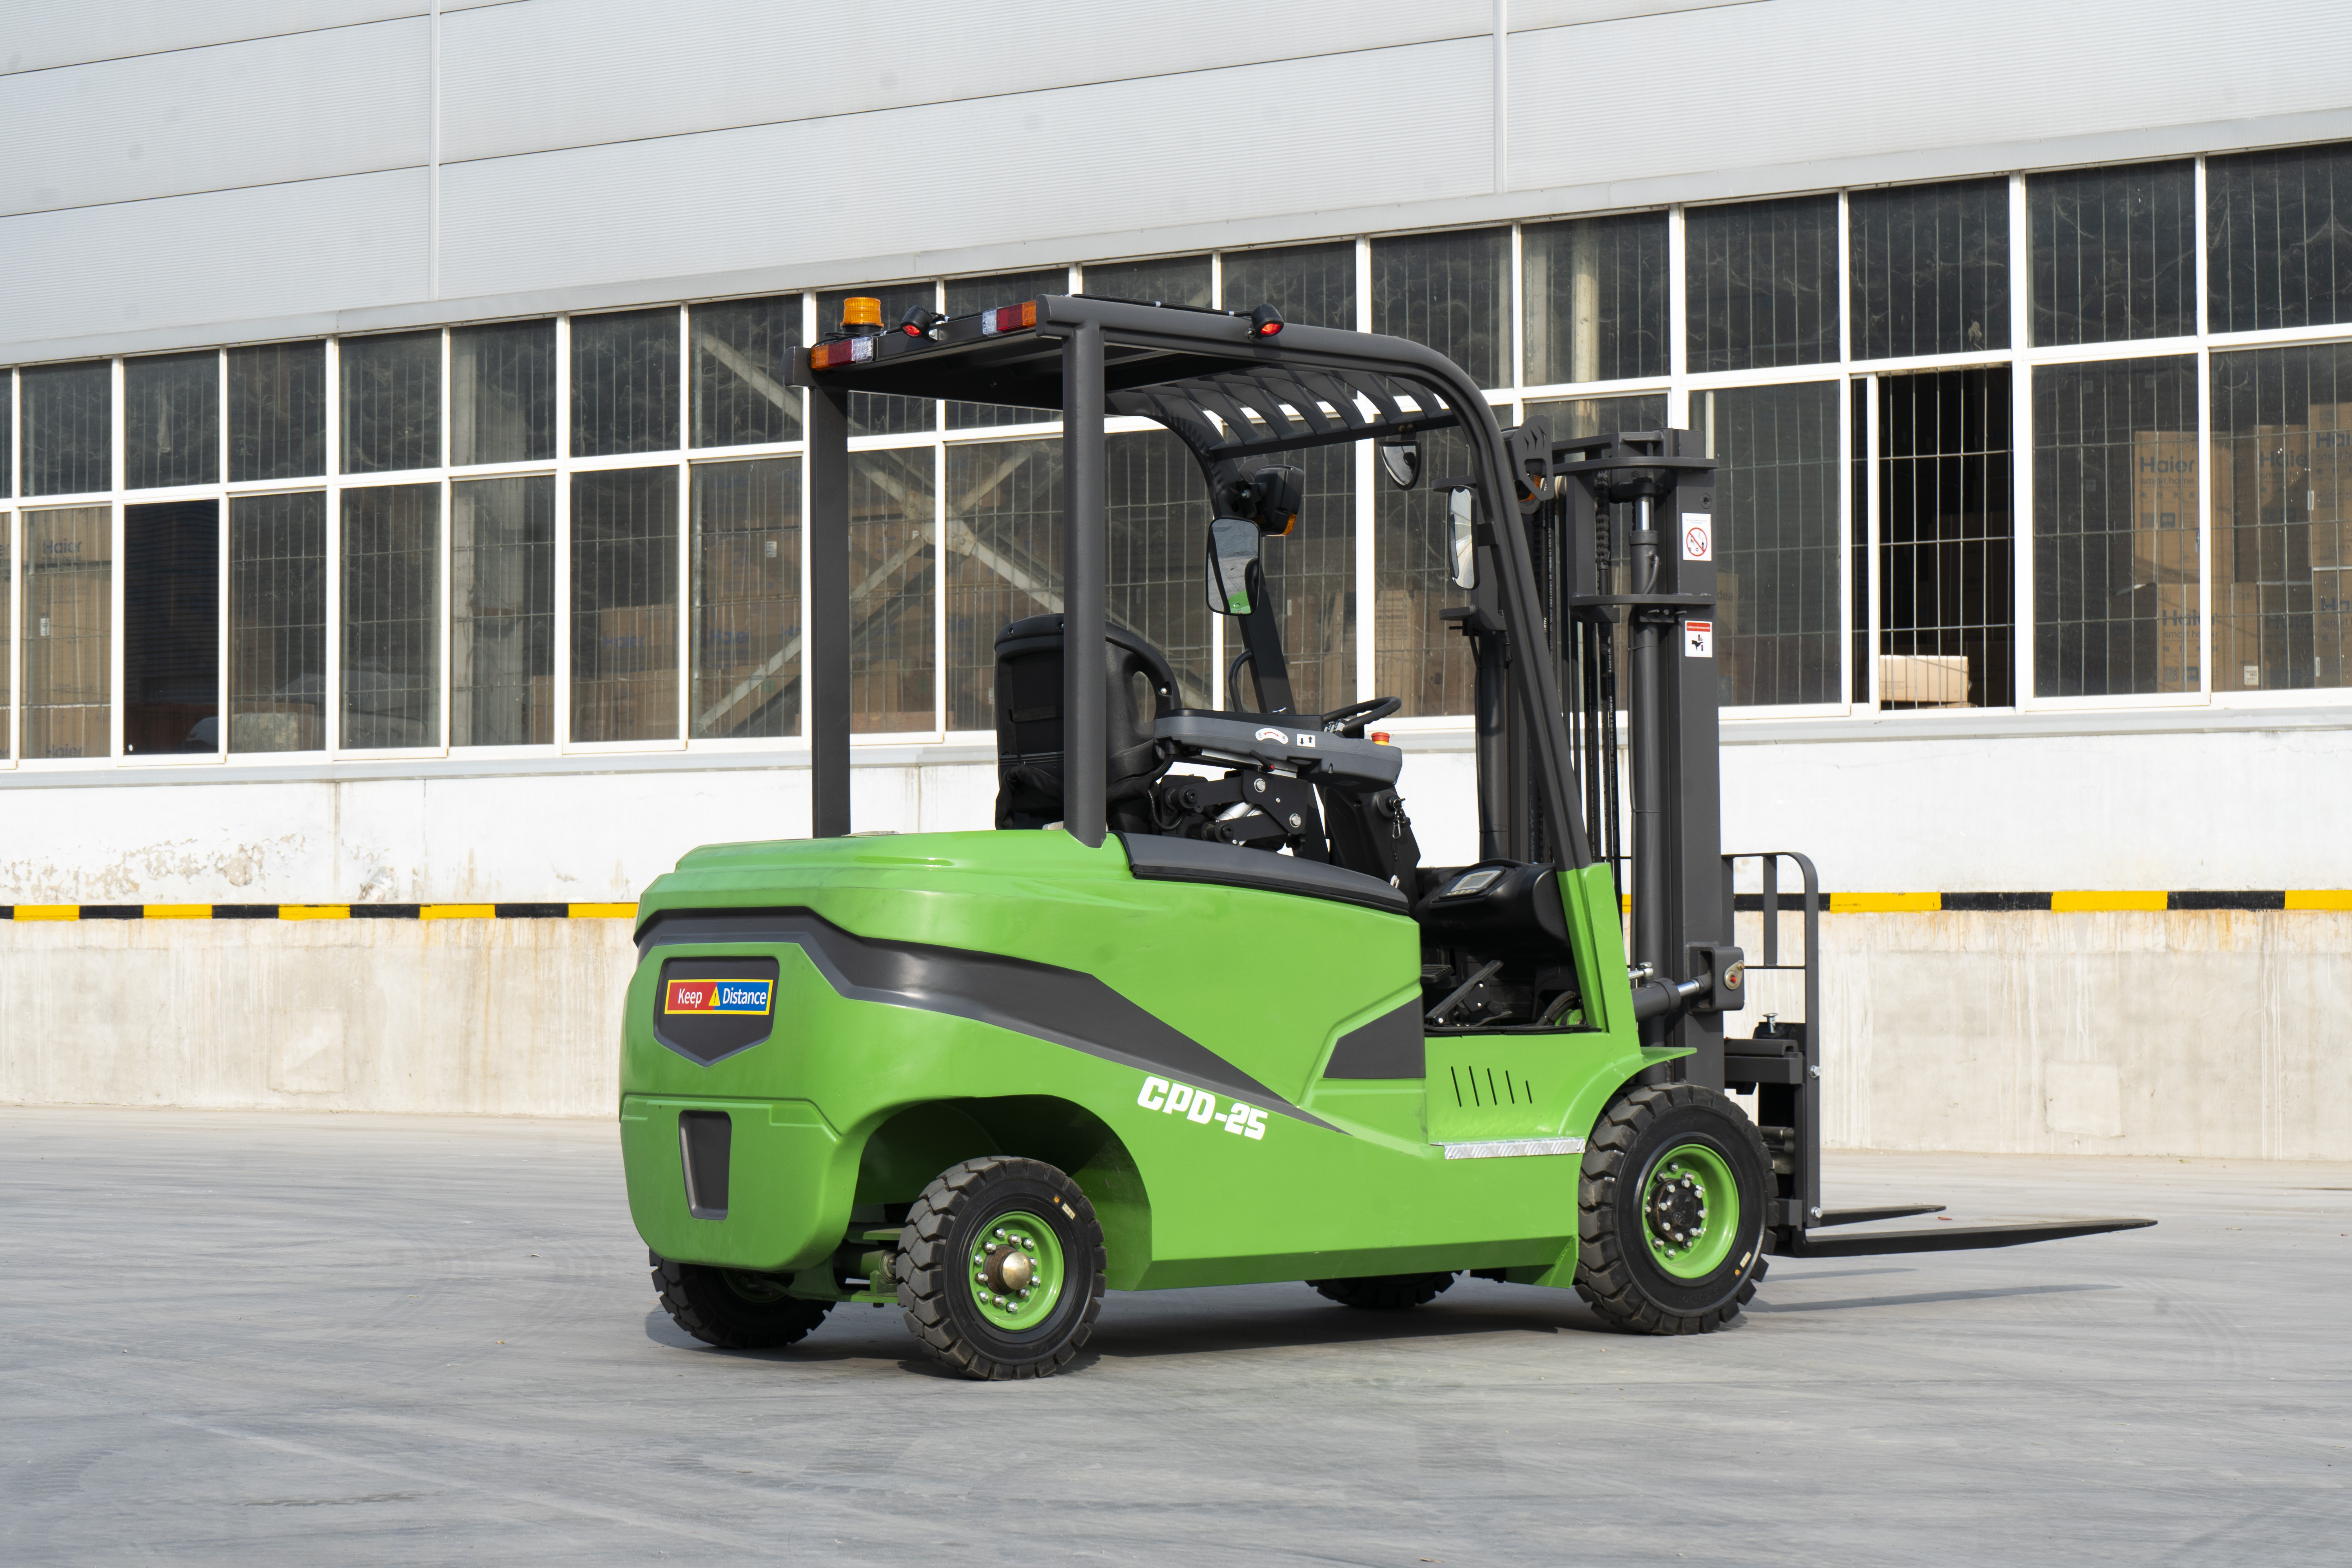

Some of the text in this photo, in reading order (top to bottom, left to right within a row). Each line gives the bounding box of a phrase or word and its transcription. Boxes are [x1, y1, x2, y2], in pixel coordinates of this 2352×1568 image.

[2316, 430, 2352, 448] Hai
[2140, 456, 2195, 472] Haier
[2260, 450, 2308, 467] Haie
[2169, 476, 2195, 485] home
[42, 538, 82, 554] Haier
[1717, 590, 1733, 601] dea
[2163, 609, 2218, 626] Hair
[603, 633, 644, 650] Haier
[710, 629, 750, 645] Haer
[45, 743, 82, 757] Haier
[678, 987, 767, 1008] Keep Distance
[1137, 1075, 1269, 1141] CPD-25
